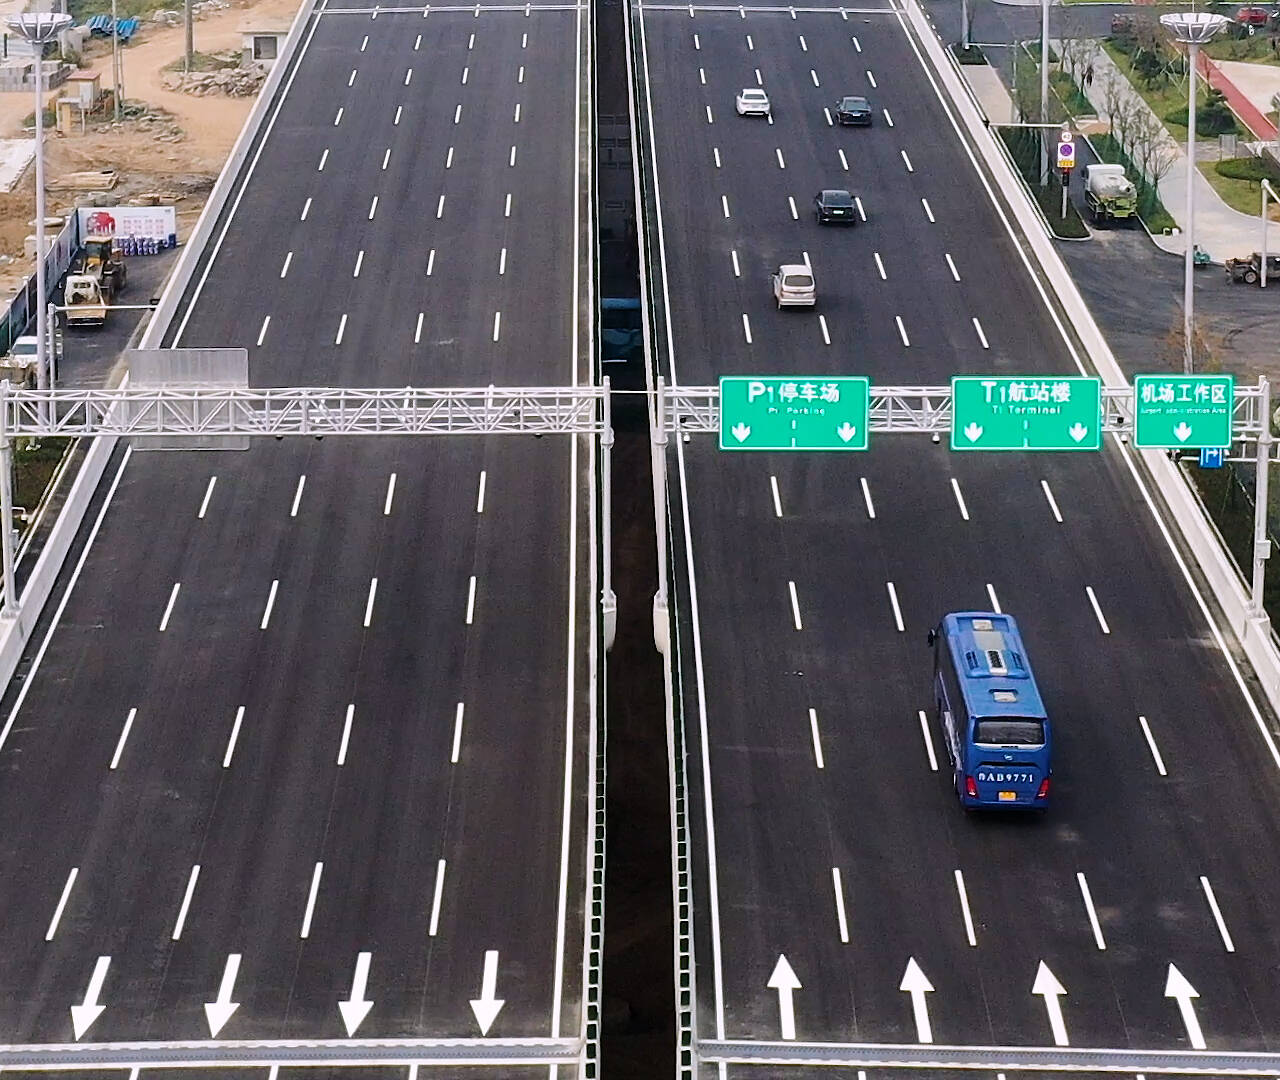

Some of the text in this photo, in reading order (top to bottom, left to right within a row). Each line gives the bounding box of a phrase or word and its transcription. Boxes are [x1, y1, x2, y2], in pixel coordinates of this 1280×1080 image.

[748, 381, 840, 403] P1停车场
[980, 381, 1071, 403] T1航站楼
[1141, 383, 1227, 404] 机场工作区
[786, 407, 826, 416] Parking
[1008, 405, 1061, 414] Terminal
